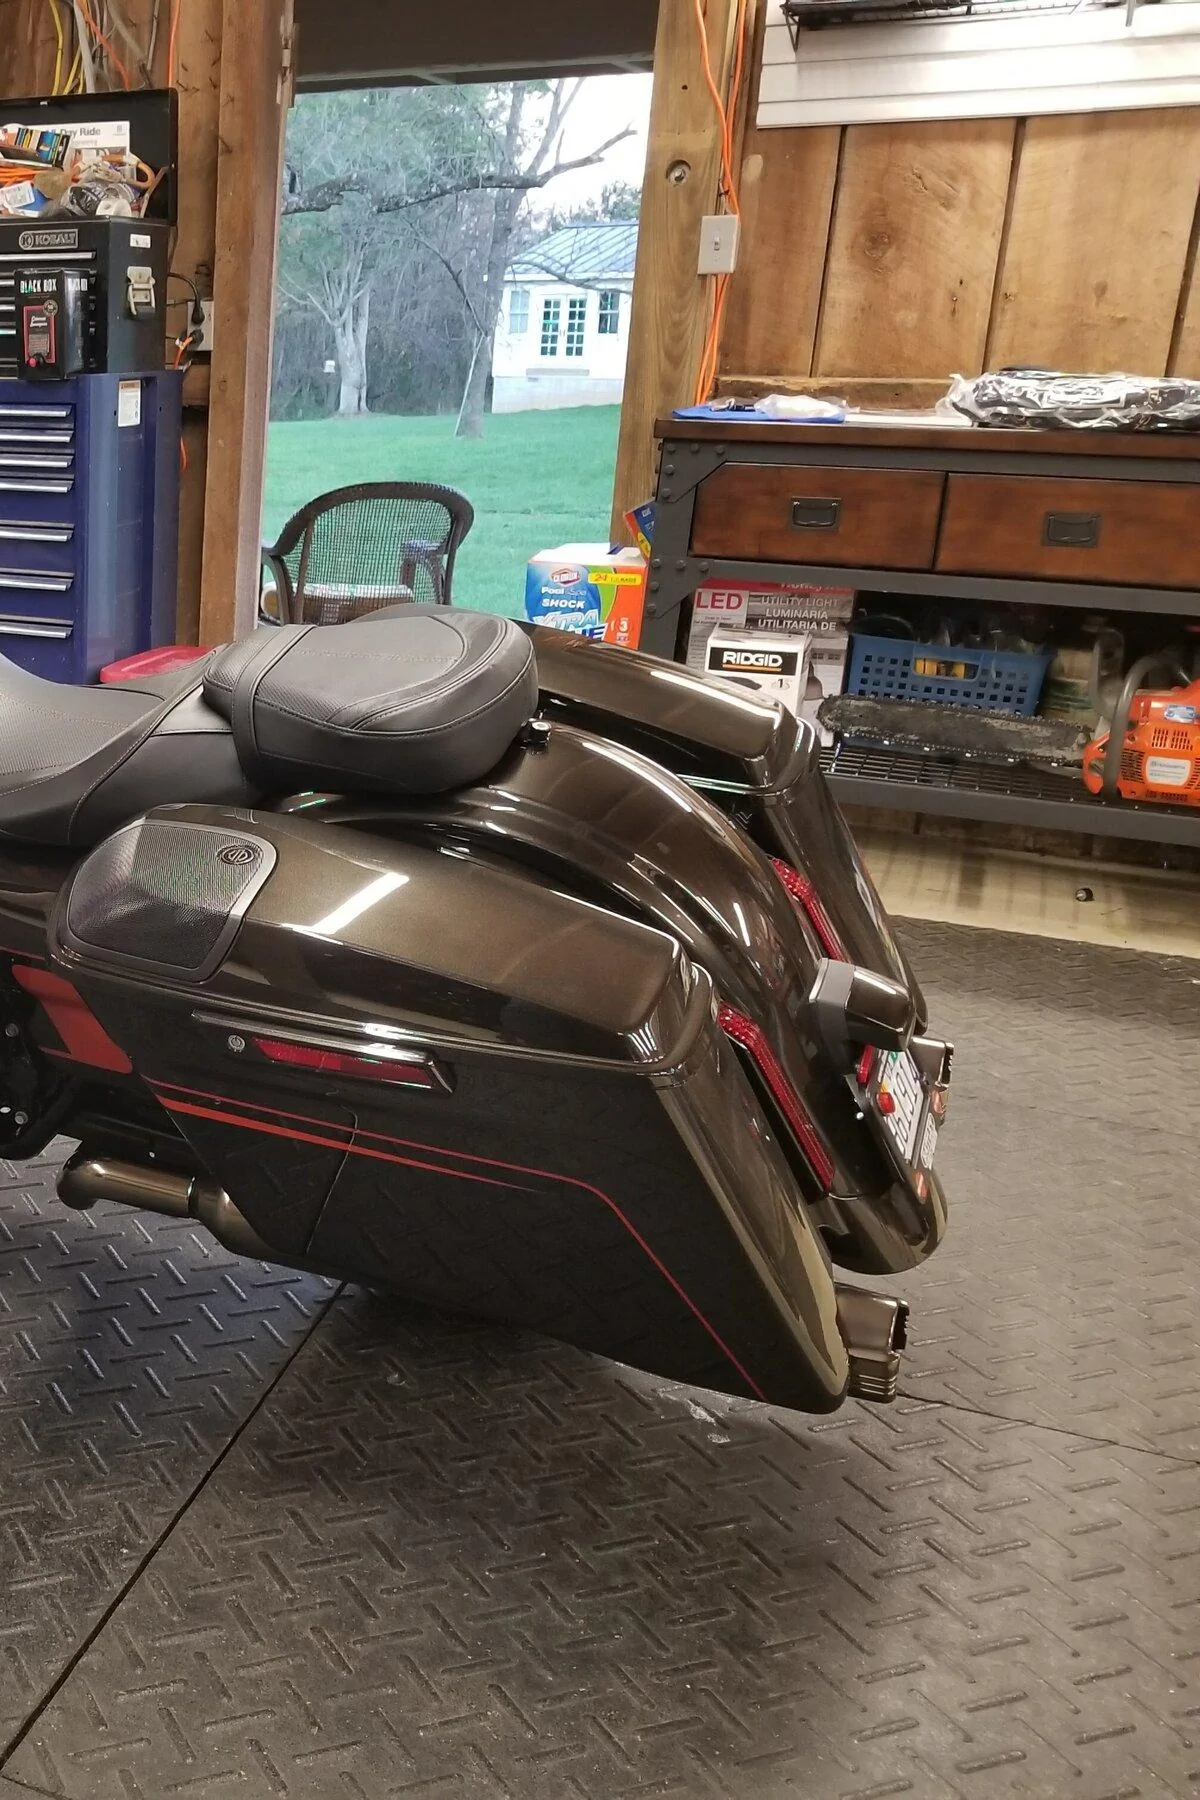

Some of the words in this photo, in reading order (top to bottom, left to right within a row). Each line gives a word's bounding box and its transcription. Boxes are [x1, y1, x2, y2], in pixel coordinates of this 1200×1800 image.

[79, 127, 101, 136] Ride
[35, 231, 76, 246] KOBALT
[20, 279, 42, 294] BLACK
[43, 278, 57, 293] BOX
[541, 585, 565, 595] Pool
[541, 598, 586, 609] SHOCK
[696, 591, 743, 610] LED
[761, 596, 802, 606] UTILITY
[806, 597, 839, 608] LIGHT
[758, 619, 818, 630] UTILITARIA
[820, 621, 837, 631] DE
[722, 651, 783, 668] RIDGID
